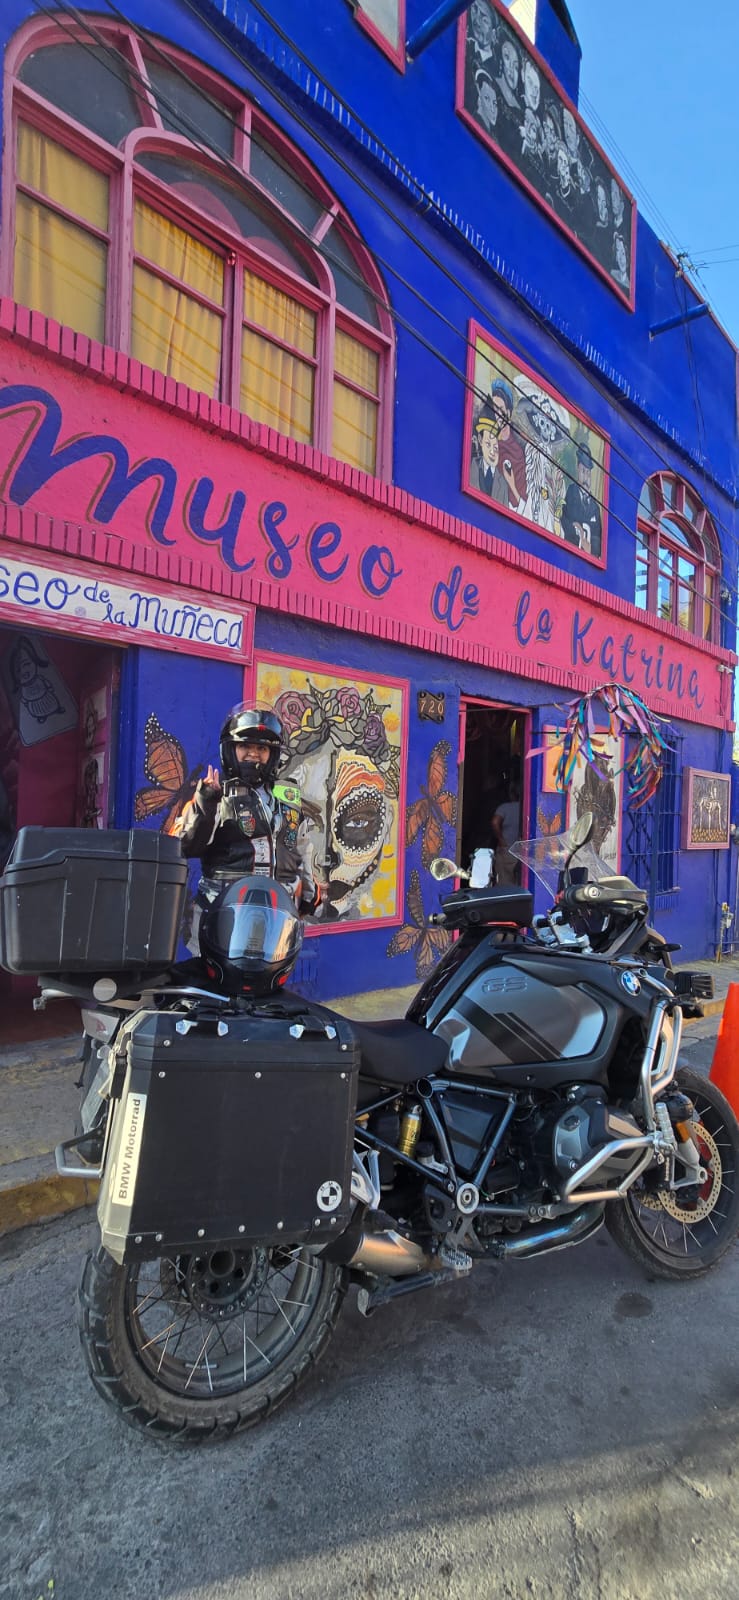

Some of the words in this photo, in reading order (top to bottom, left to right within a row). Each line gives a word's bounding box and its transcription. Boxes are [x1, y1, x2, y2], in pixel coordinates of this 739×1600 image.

[83, 581, 110, 603] de
[102, 602, 127, 626] la
[128, 592, 242, 648] Muñeca
[432, 565, 480, 631] de
[513, 590, 553, 646] la
[571, 609, 705, 708] Katrina
[420, 700, 444, 715] 720
[481, 975, 528, 993] GS
[118, 1162, 132, 1199] BMW
[125, 1099, 141, 1158] Motorrad
